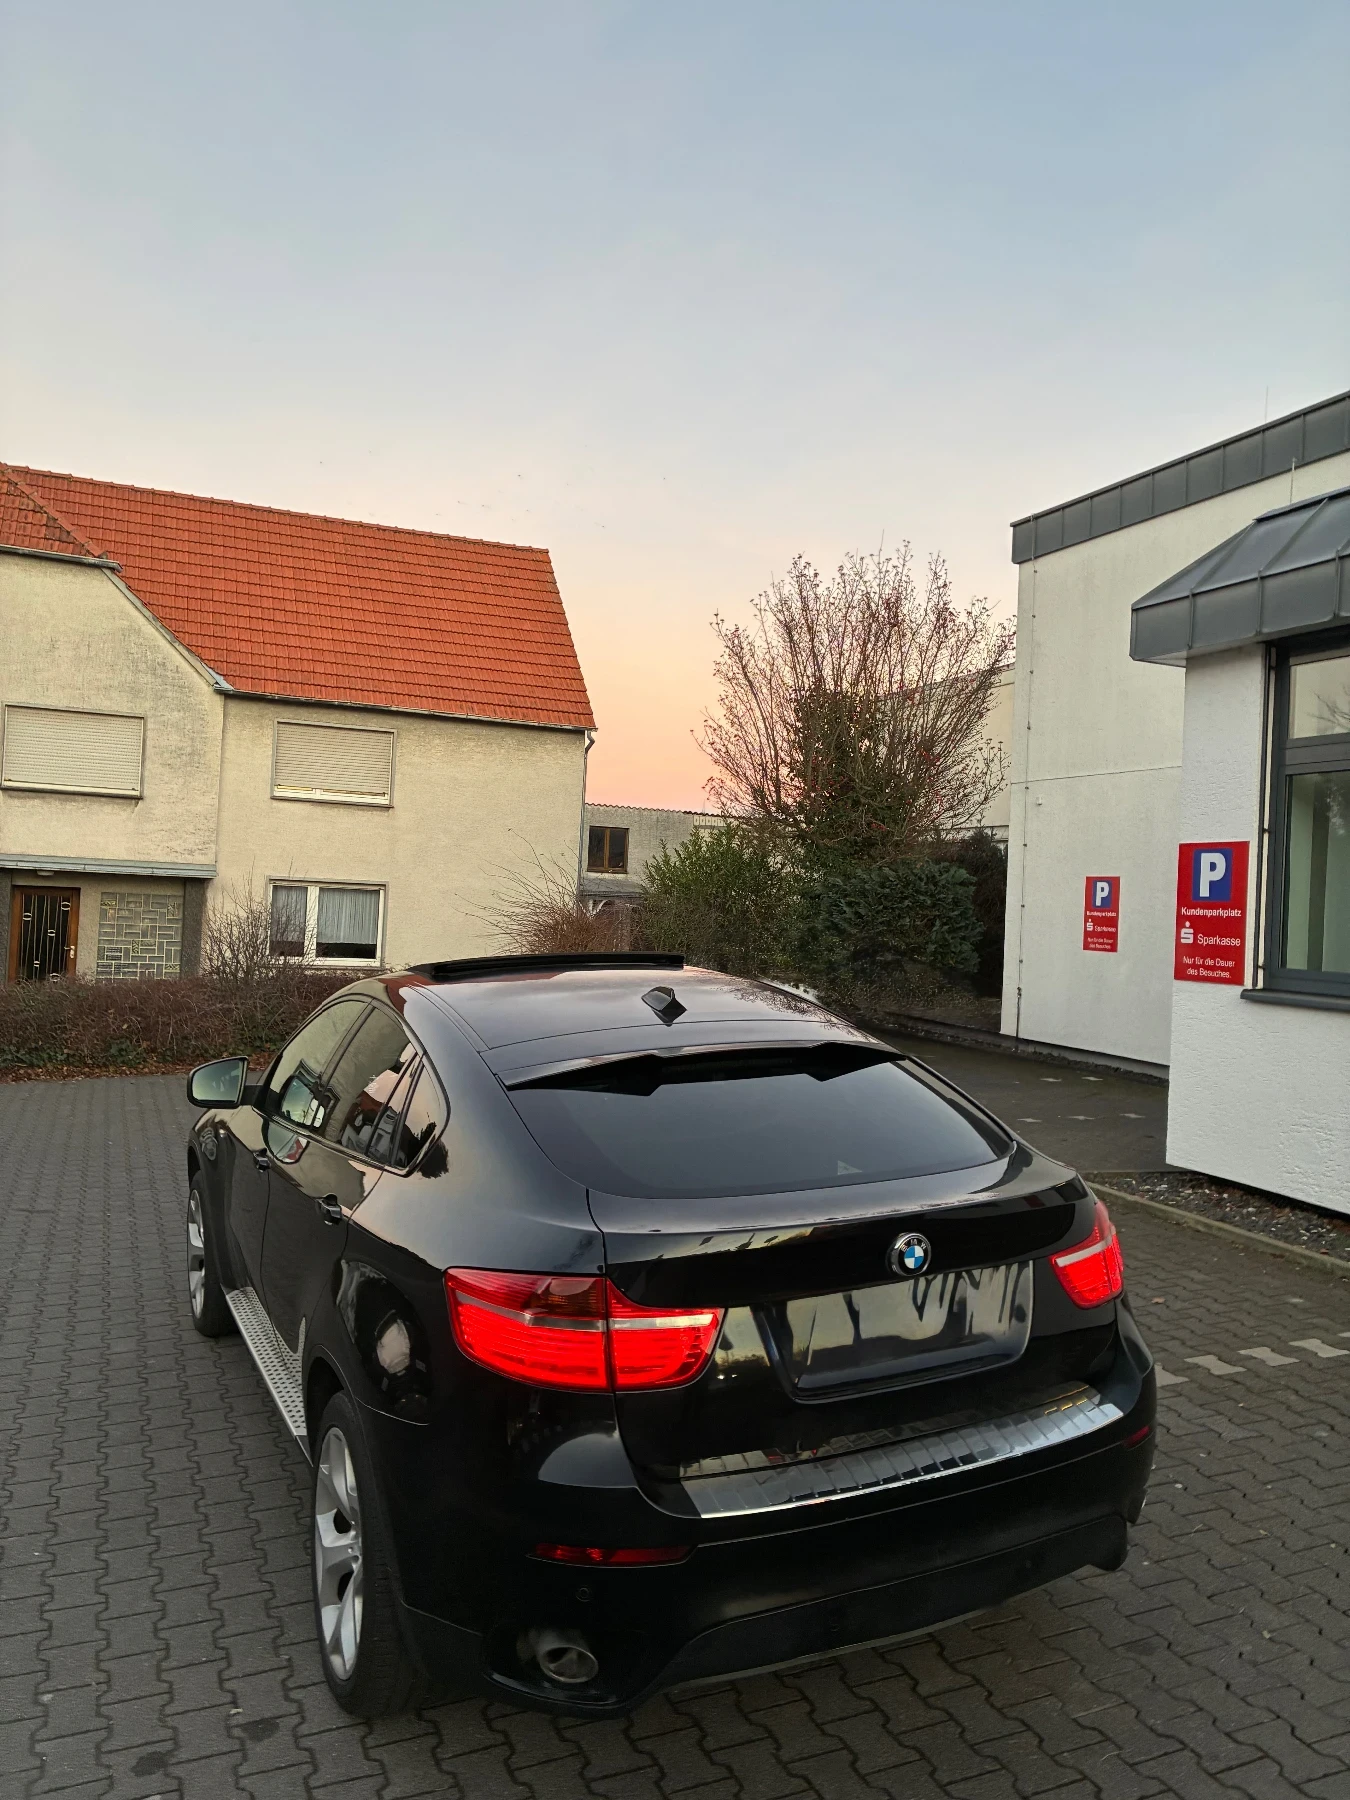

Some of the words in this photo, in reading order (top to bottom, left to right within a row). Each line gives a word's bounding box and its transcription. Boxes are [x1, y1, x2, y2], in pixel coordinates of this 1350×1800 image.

[1199, 852, 1226, 897] P
[1095, 881, 1109, 906] P
[1181, 906, 1242, 918] Kundenparkplatz
[1197, 934, 1241, 947] Sparkasse
[1182, 955, 1195, 965] Nur
[1204, 957, 1215, 966] die
[1215, 958, 1235, 968] Dauer
[1186, 967, 1198, 976] des
[1199, 968, 1232, 979] Besuches.
